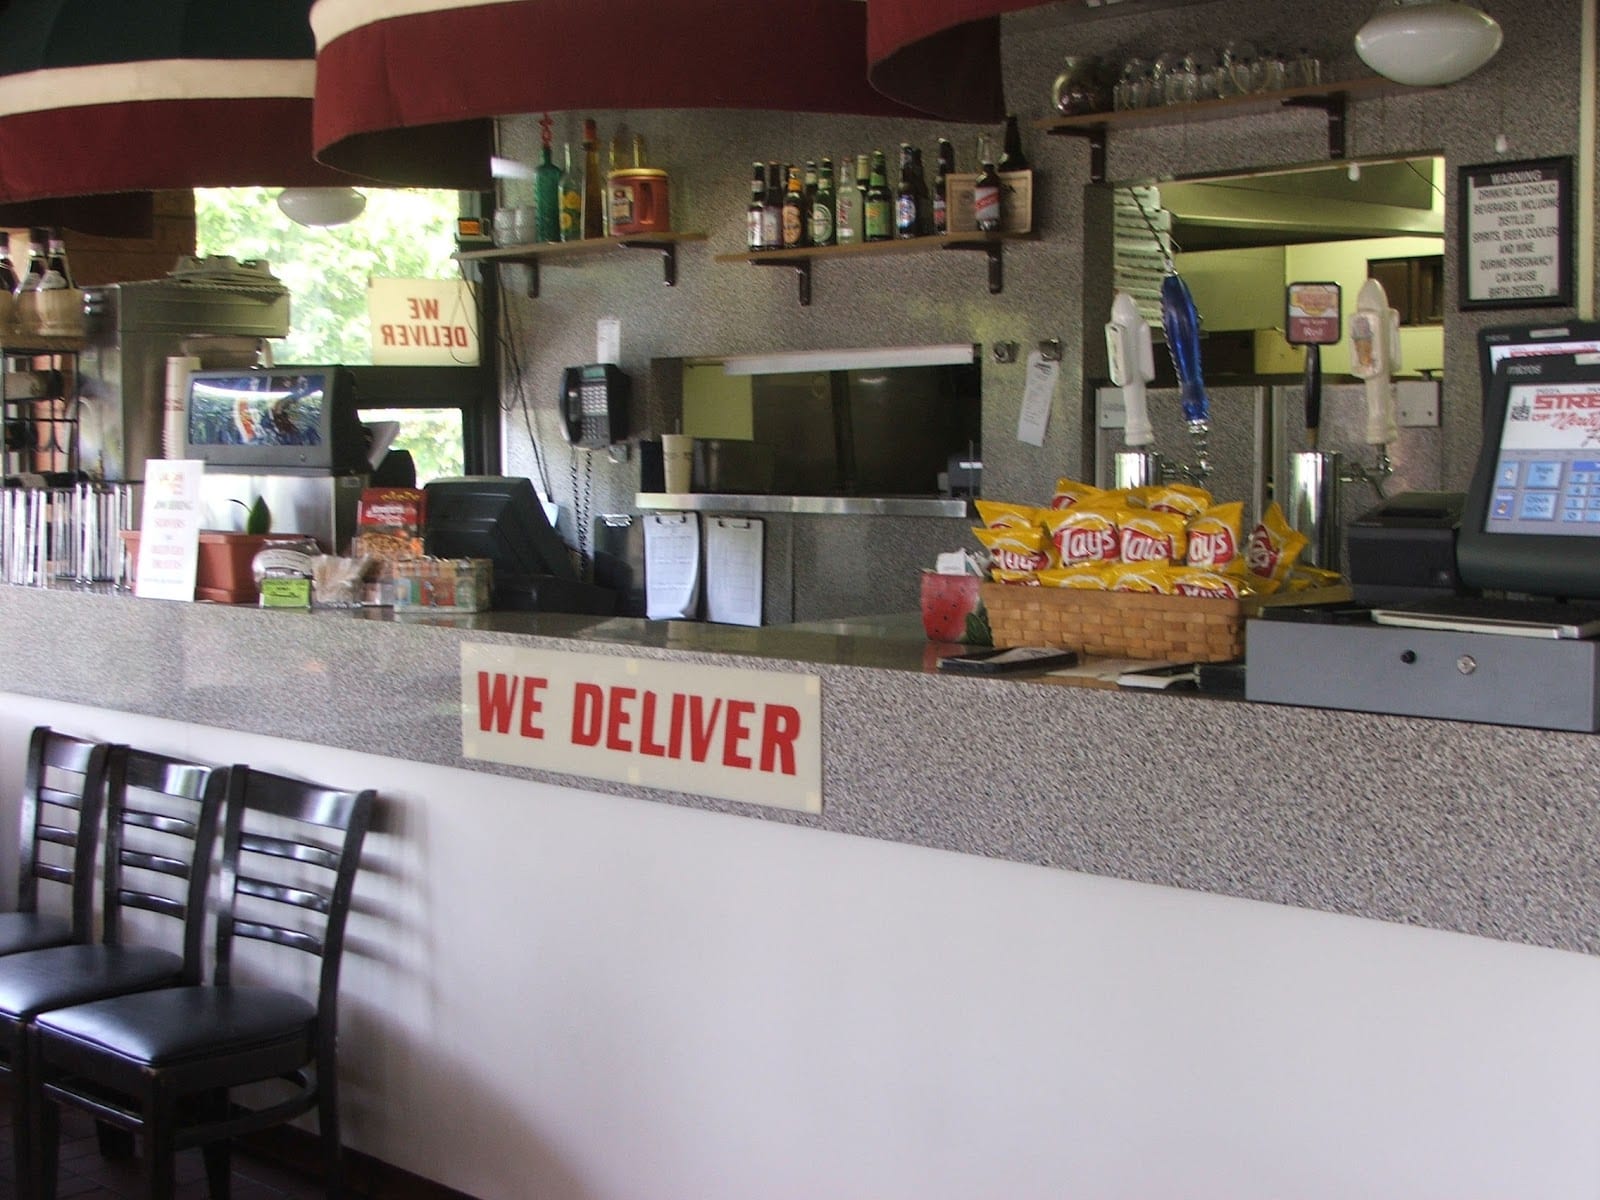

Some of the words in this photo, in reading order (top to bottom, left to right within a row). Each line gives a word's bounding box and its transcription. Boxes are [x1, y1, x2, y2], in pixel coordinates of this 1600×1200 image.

[1490, 170, 1542, 185] WARNING
[477, 671, 549, 740] WE
[570, 682, 802, 776] DELIVER
